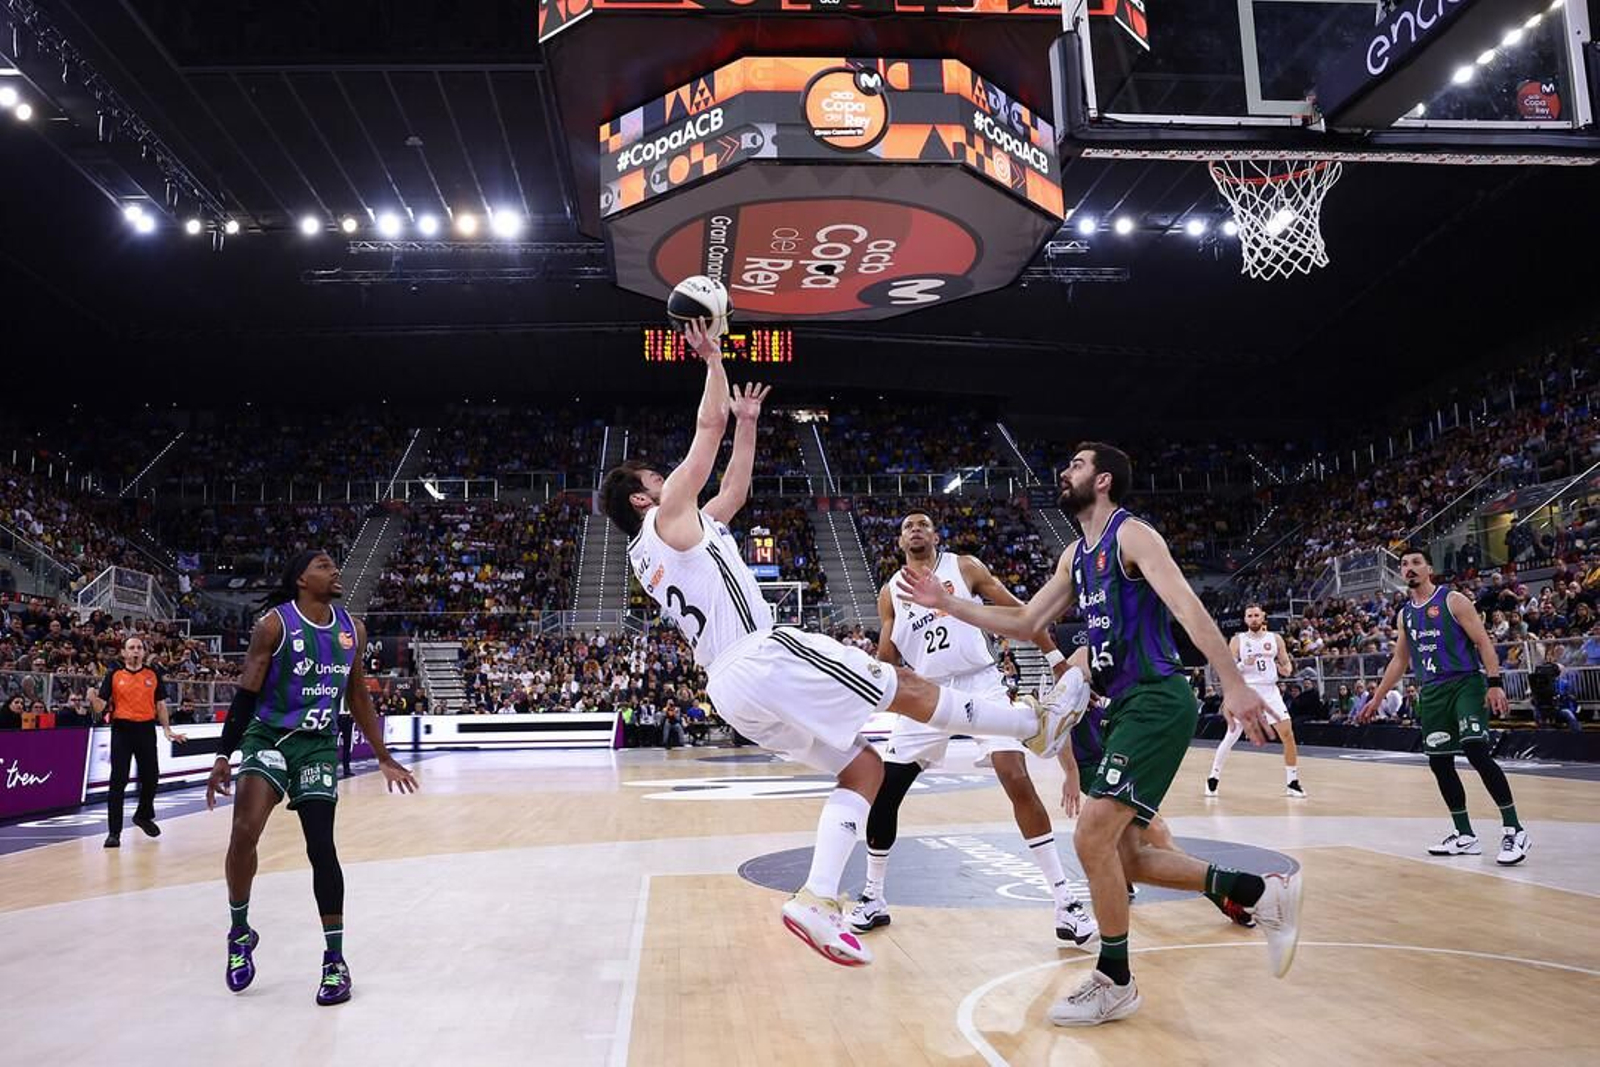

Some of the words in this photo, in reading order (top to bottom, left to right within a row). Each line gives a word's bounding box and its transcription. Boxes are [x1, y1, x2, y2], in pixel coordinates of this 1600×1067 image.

[821, 99, 866, 115] Copa
[845, 113, 872, 130] Rey
[616, 107, 724, 173] #CopaACB
[973, 110, 1049, 174] #CopaACB
[710, 215, 733, 244] Gran
[770, 226, 803, 255] del
[800, 223, 868, 289] Copa
[858, 239, 897, 274] acb
[731, 257, 794, 296] Rey
[756, 547, 771, 563] 14
[924, 626, 950, 654] 22
[314, 663, 351, 676] Unicaj
[1256, 660, 1267, 672] 13
[301, 708, 333, 730] 55
[6, 759, 53, 789] tren
